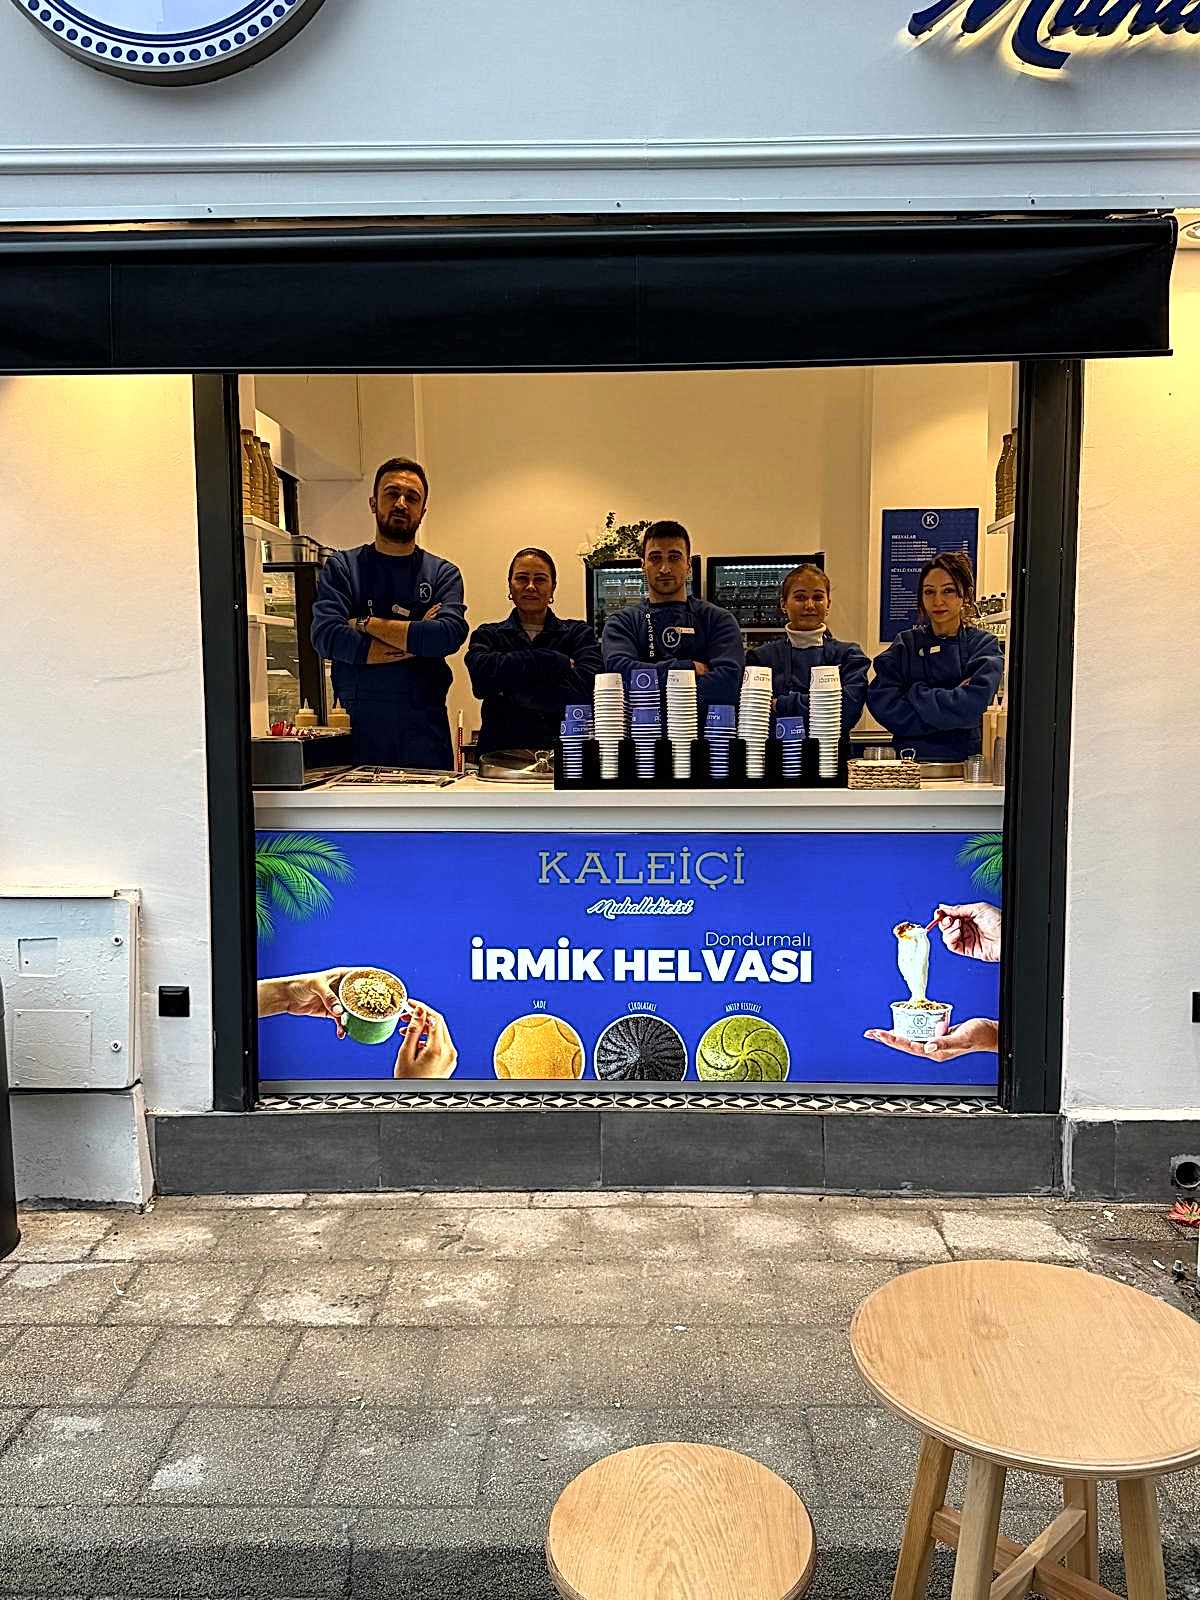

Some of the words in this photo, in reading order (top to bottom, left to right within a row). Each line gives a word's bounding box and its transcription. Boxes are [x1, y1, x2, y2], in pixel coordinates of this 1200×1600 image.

[926, 515, 934, 525] K
[666, 632, 675, 643] K
[538, 847, 745, 890] KALEİÇİ
[705, 931, 811, 947] Dondurmalı
[471, 936, 604, 981] İRMİK
[614, 949, 812, 983] HELVASI
